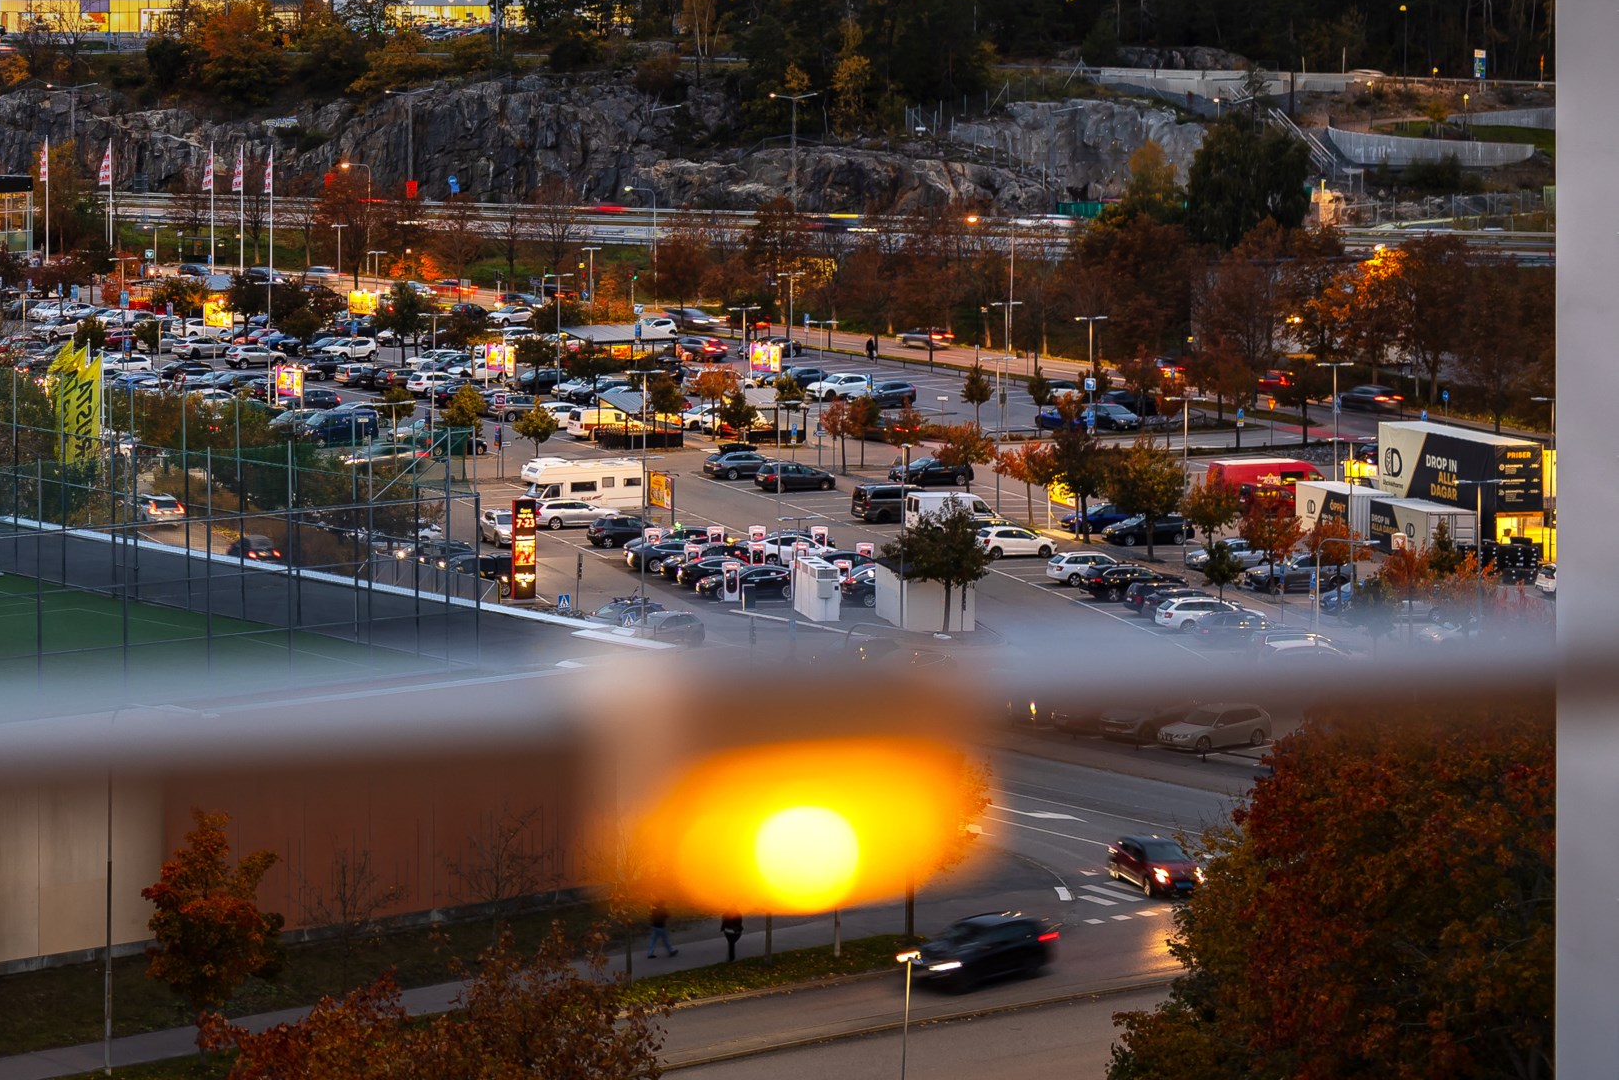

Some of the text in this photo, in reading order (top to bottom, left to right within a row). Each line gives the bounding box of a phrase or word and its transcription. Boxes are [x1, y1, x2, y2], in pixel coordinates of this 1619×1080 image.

[1425, 454, 1458, 473] DROP IN
[1438, 471, 1458, 487] ALLA
[1430, 483, 1458, 501] DAGAR
